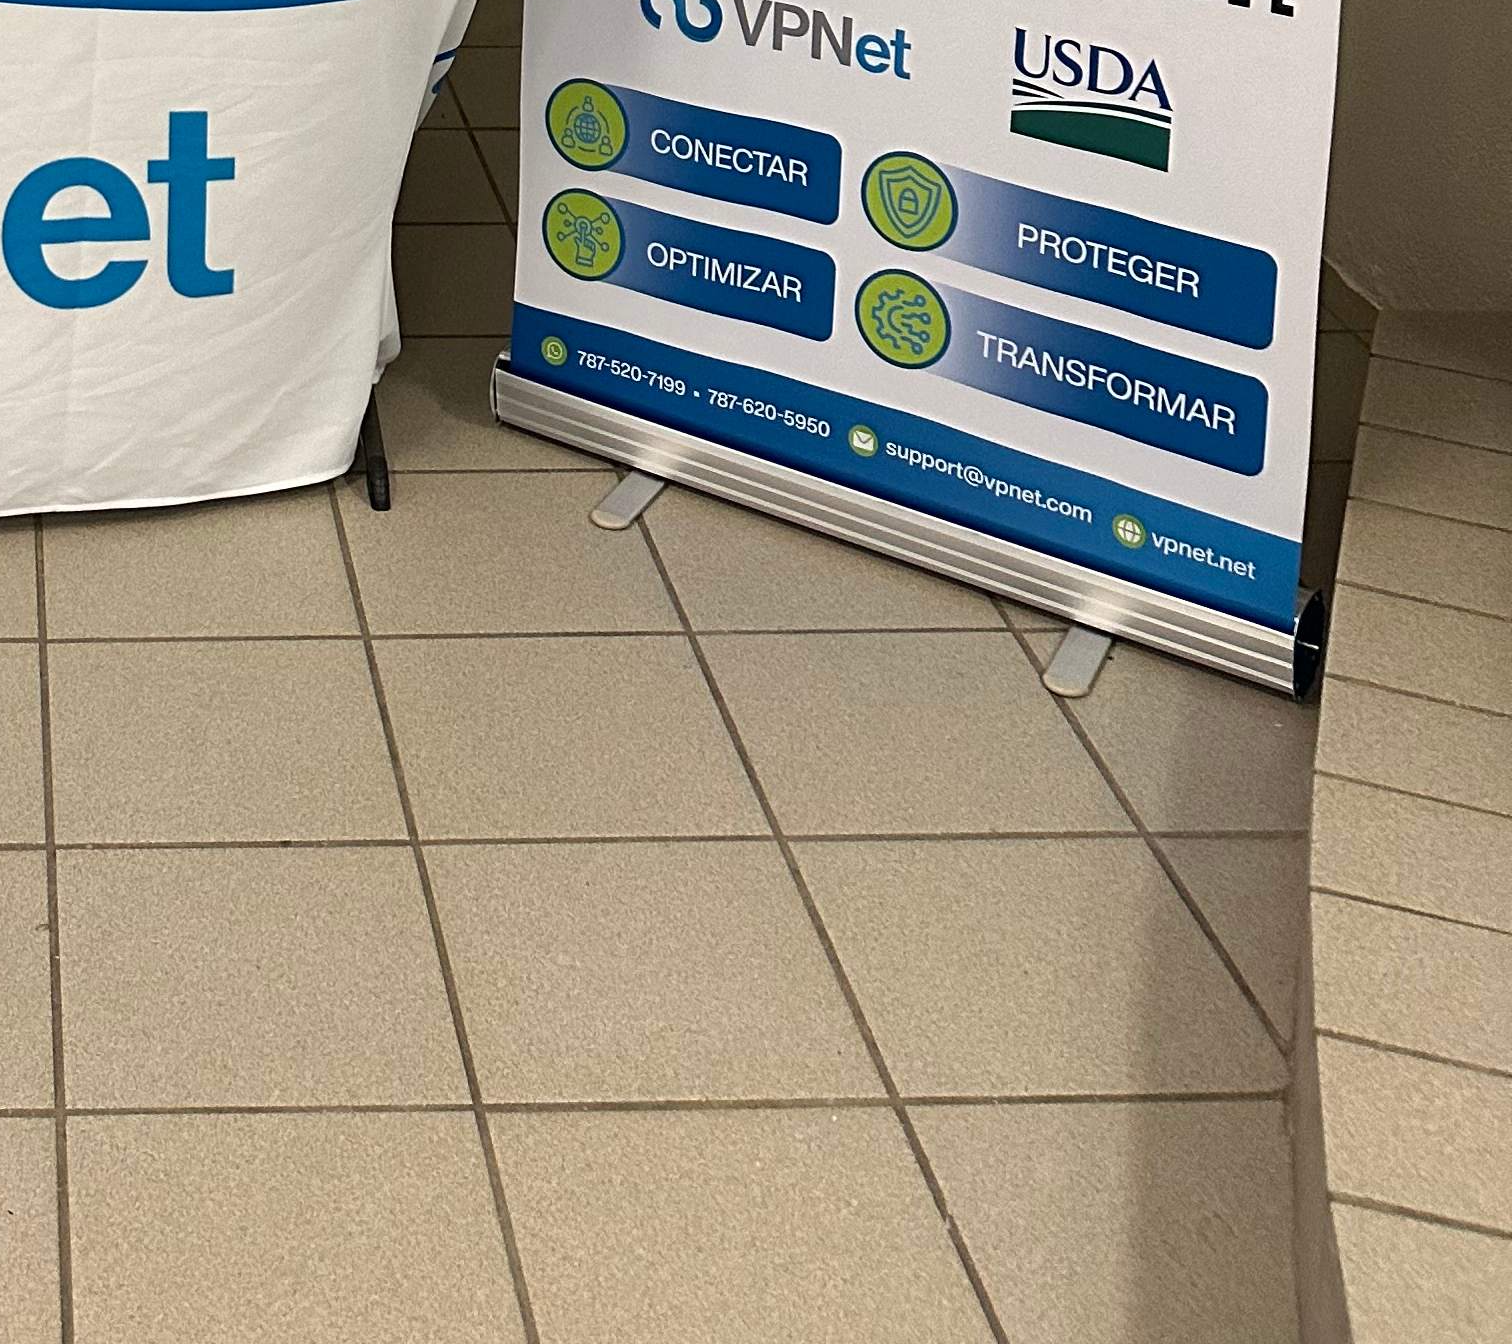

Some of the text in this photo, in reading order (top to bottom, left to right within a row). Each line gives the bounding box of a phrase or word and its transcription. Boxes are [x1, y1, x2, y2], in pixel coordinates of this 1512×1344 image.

[1013, 27, 1175, 113] USDA
[650, 128, 809, 188] CONECTAR
[646, 241, 804, 303] OPTIMIZAR
[1016, 223, 1202, 299] PROTEGER
[576, 350, 831, 438] 787-520-7199 787-620-5950
[976, 330, 1238, 437] TRANSFORMAR
[885, 440, 1093, 524] support@vpnet.com
[1150, 533, 1256, 580] vpnet.net
